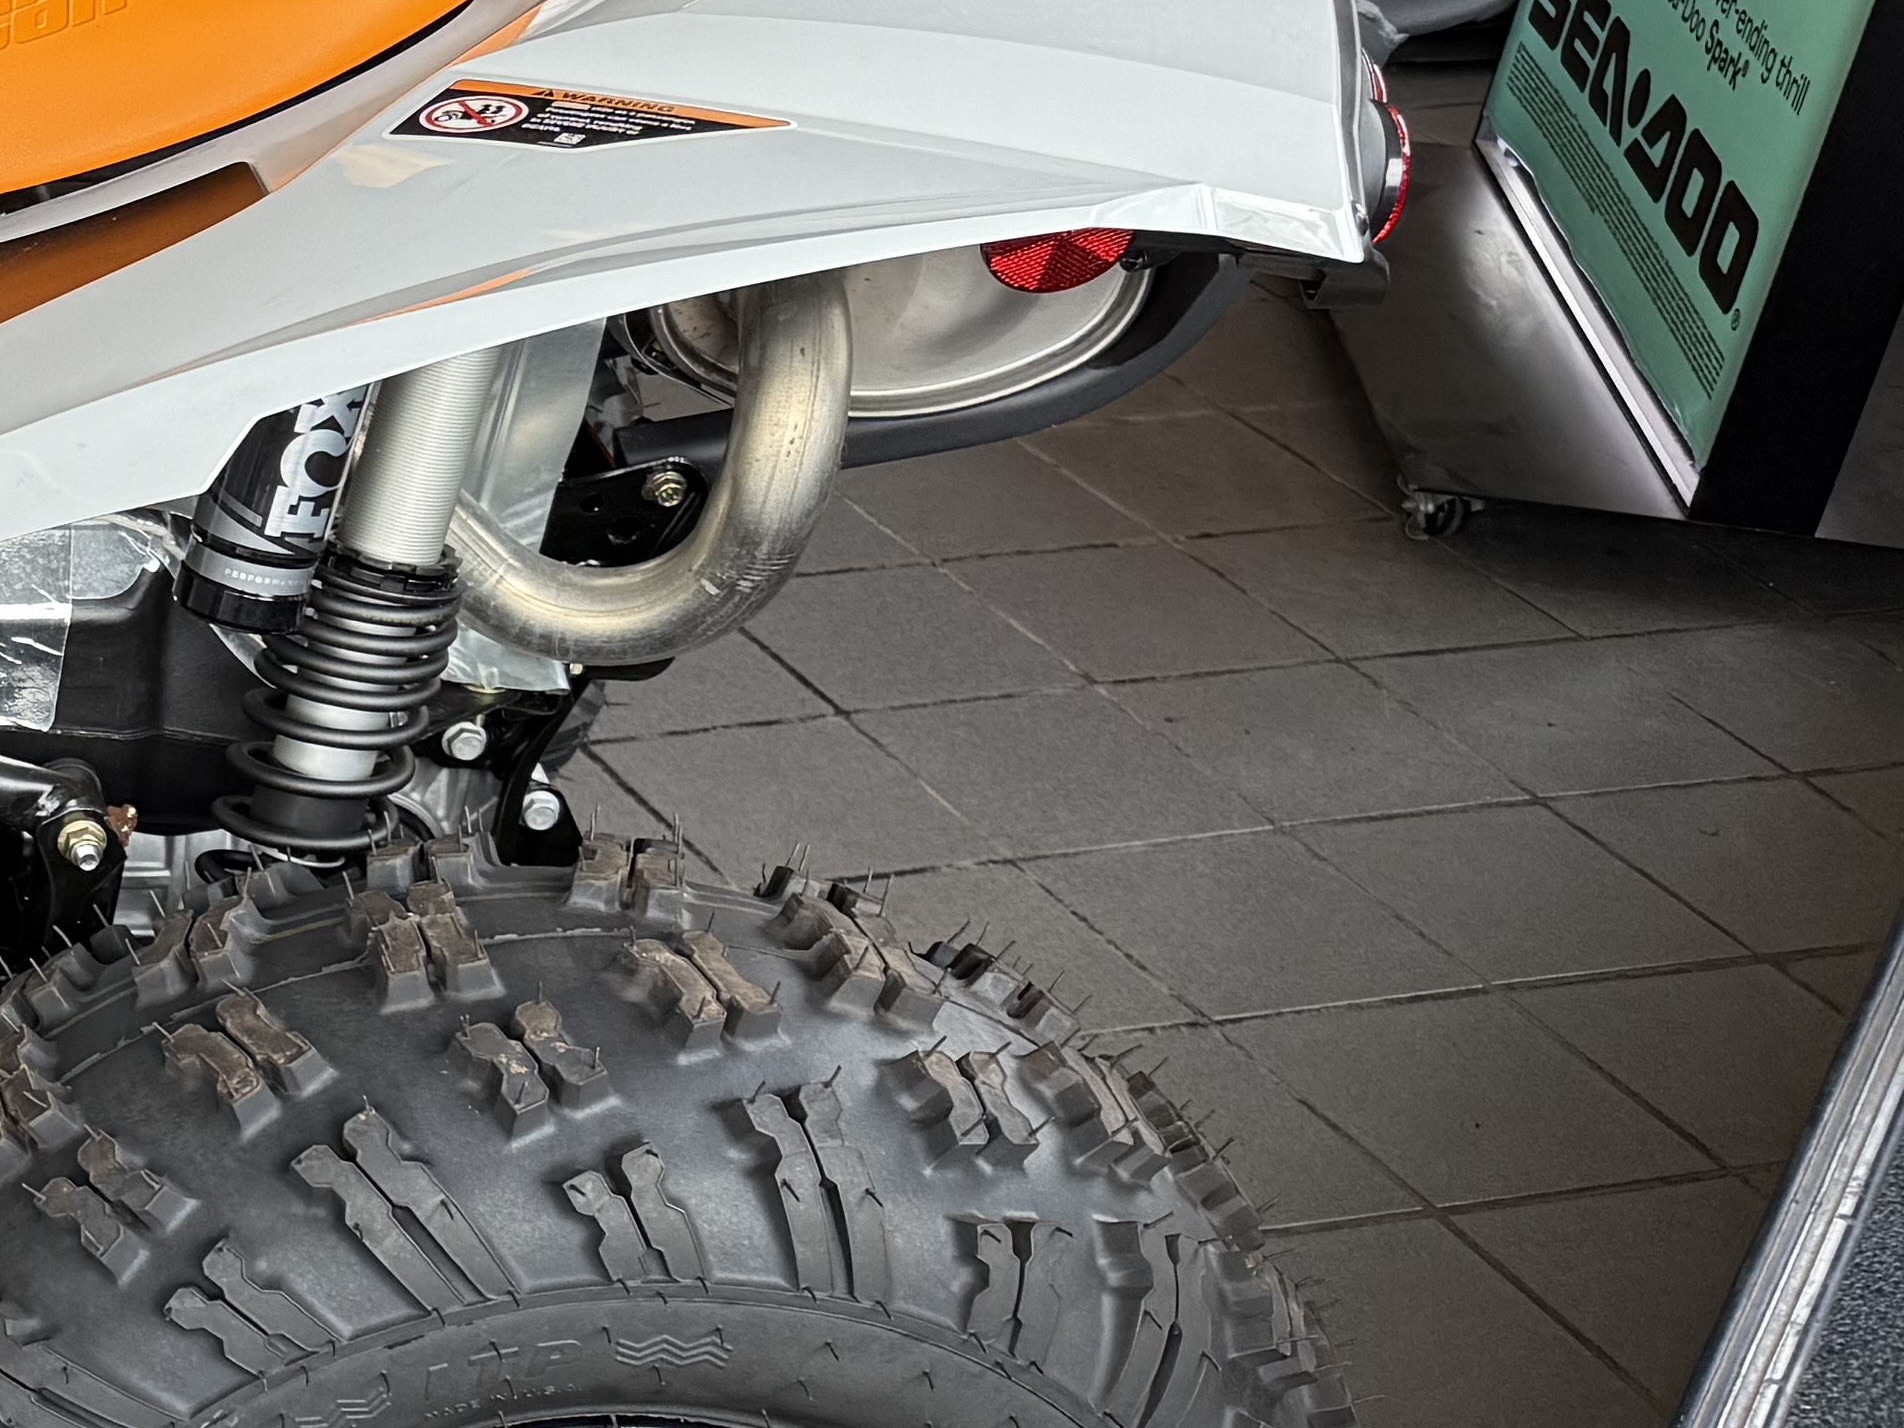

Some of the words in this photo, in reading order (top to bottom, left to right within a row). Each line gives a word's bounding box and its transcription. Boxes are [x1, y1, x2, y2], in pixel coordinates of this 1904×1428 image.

[562, 93, 675, 112] WARNING
[1777, 54, 1812, 116] thrill
[264, 385, 366, 538] FOX
